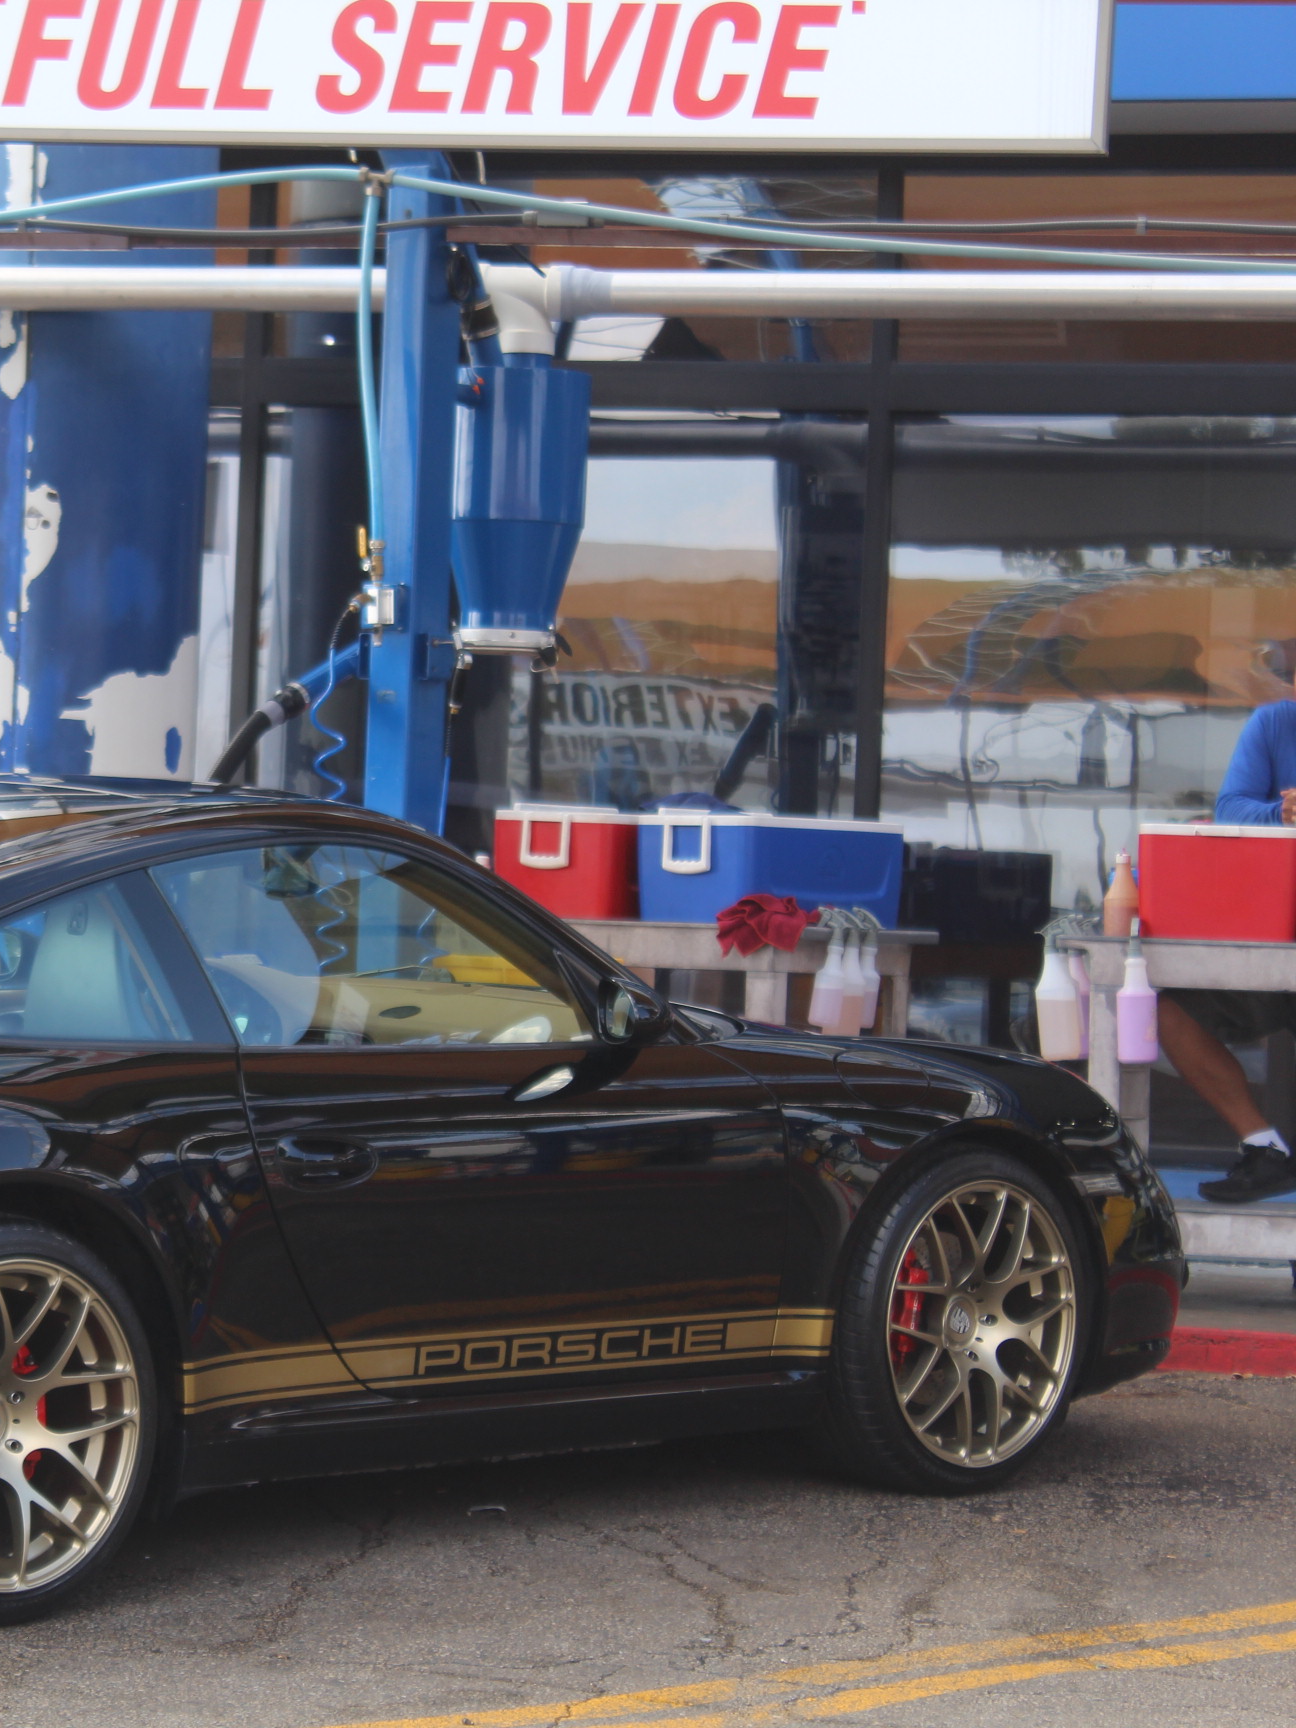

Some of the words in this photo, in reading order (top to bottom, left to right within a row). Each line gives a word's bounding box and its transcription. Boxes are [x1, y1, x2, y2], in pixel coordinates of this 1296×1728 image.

[1, 0, 273, 111] FULL
[315, 0, 842, 120] SERVICE
[418, 1323, 724, 1375] PORSCHE
